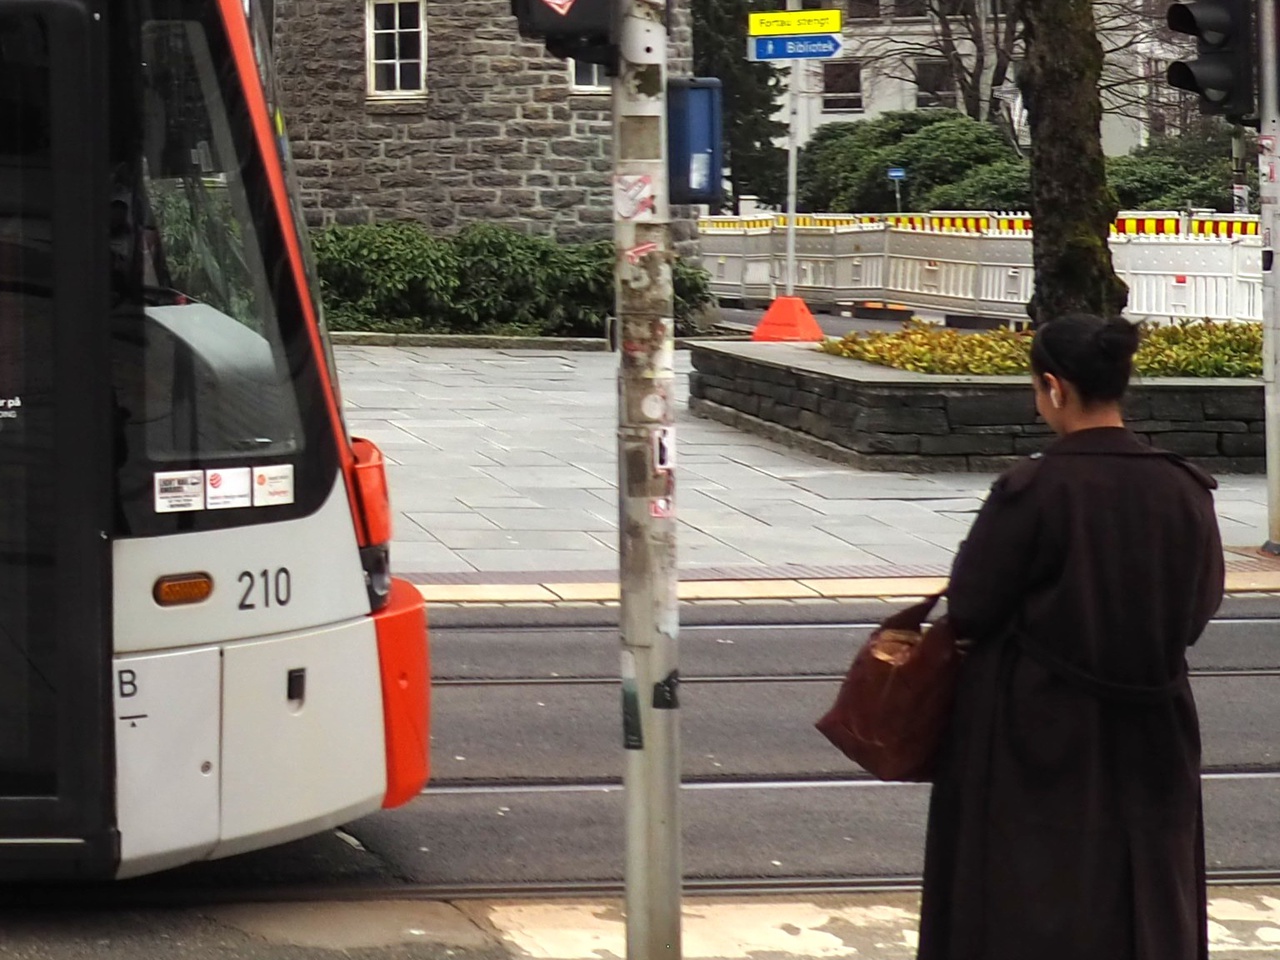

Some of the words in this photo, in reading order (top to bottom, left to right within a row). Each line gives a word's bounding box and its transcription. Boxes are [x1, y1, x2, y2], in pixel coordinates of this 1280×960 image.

[786, 39, 835, 54] Bibliotek
[237, 567, 291, 610] 210
[118, 669, 137, 698] B
